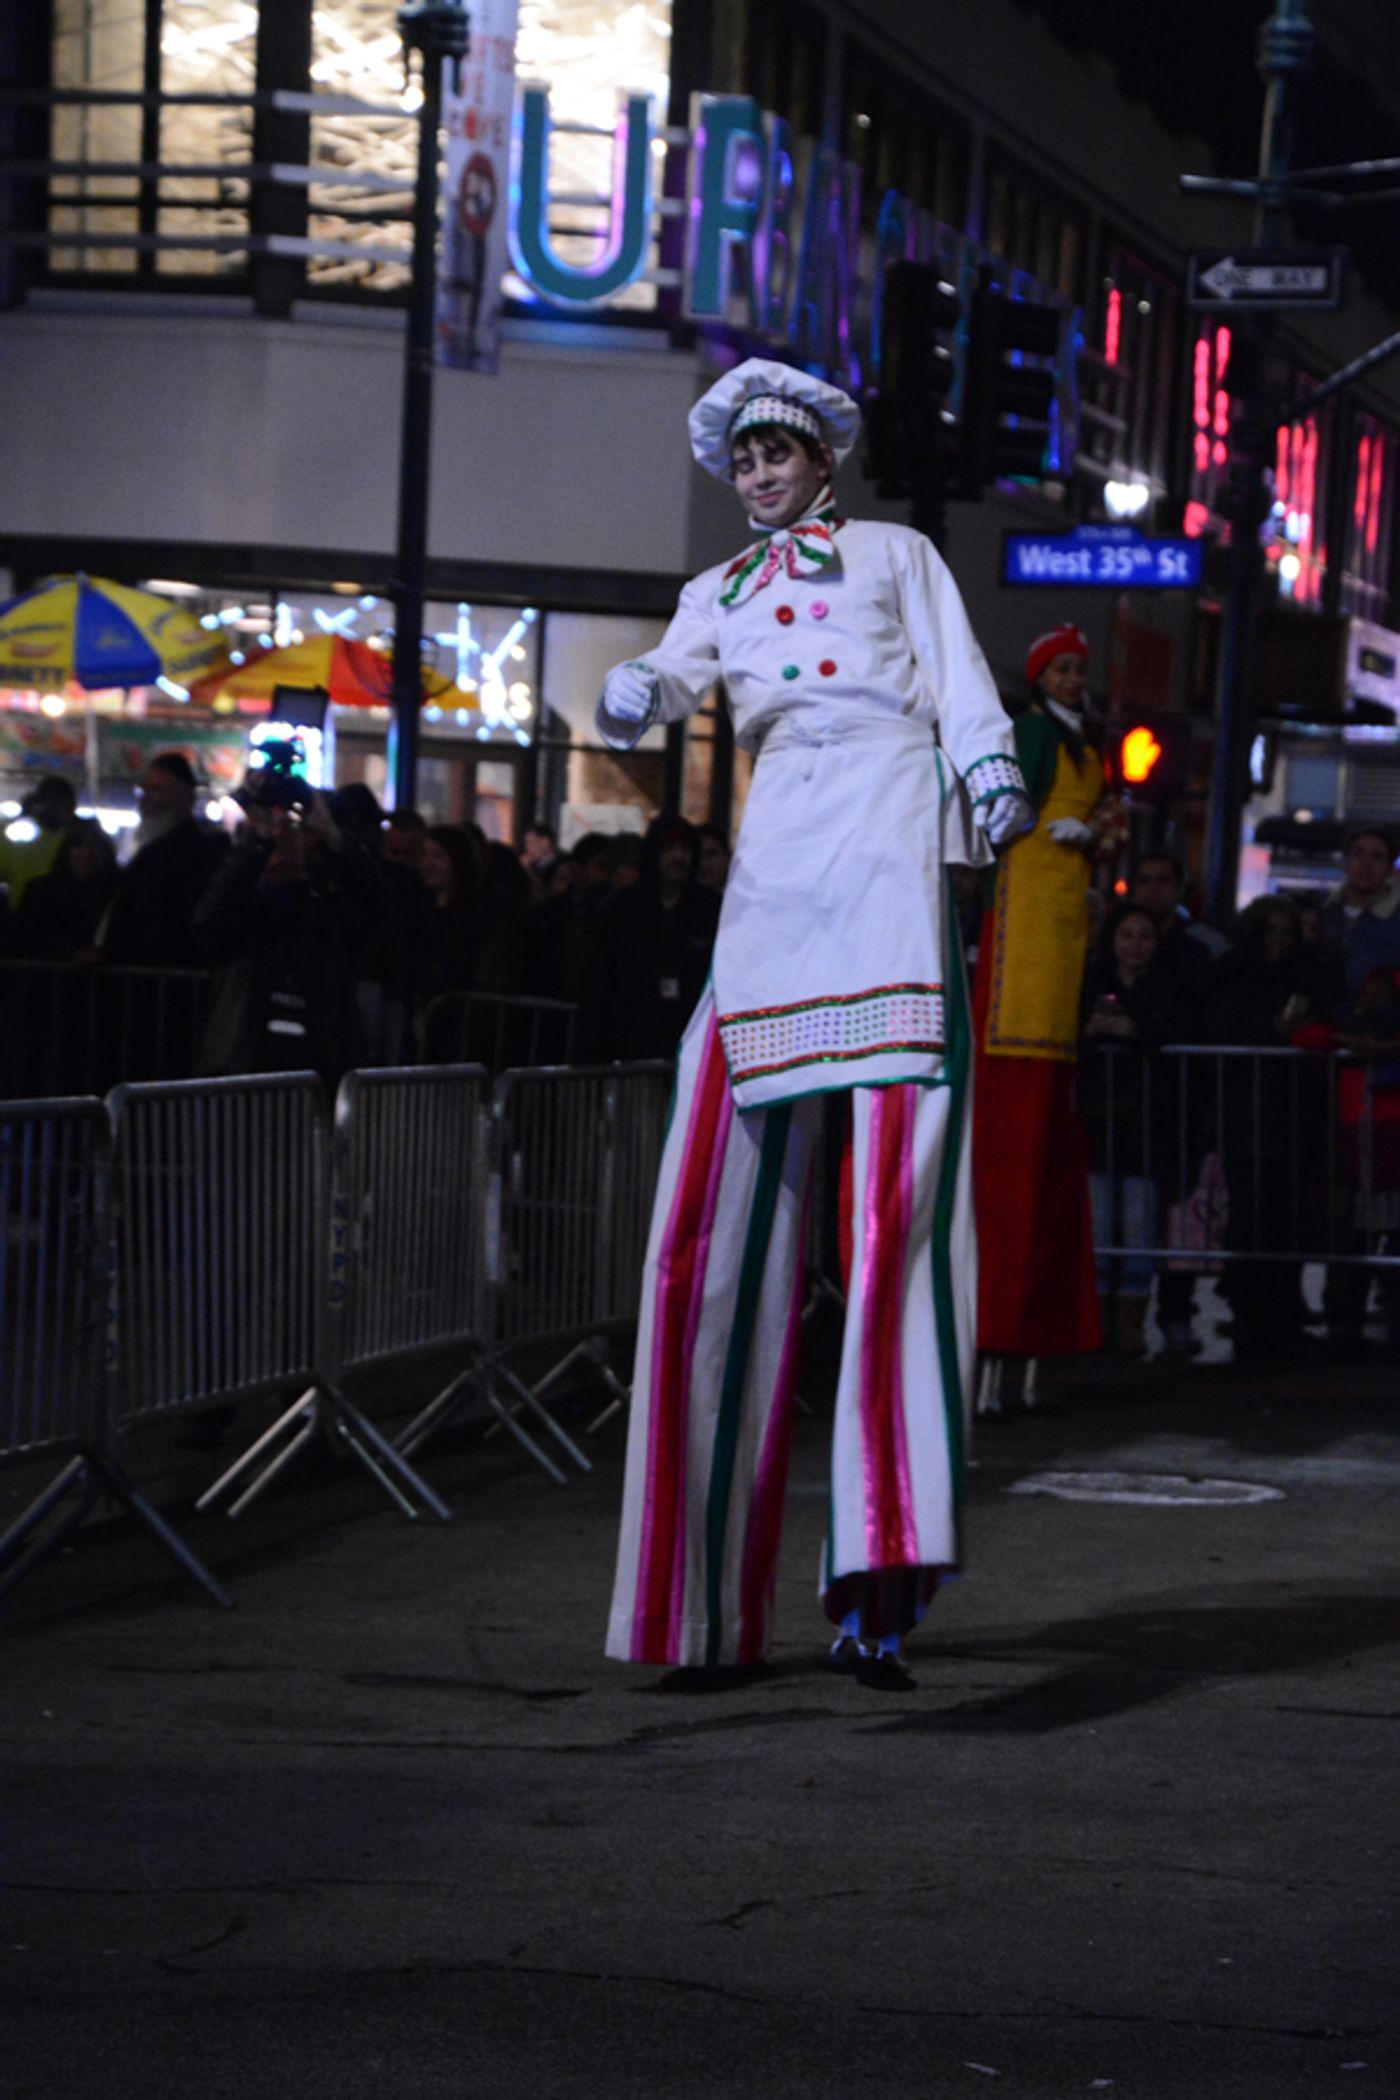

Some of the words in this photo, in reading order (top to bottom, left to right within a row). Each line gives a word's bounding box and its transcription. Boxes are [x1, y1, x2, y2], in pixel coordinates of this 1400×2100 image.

[1018, 543, 1091, 578] West
[1098, 545, 1152, 579] 35th
[1157, 547, 1189, 580] St
